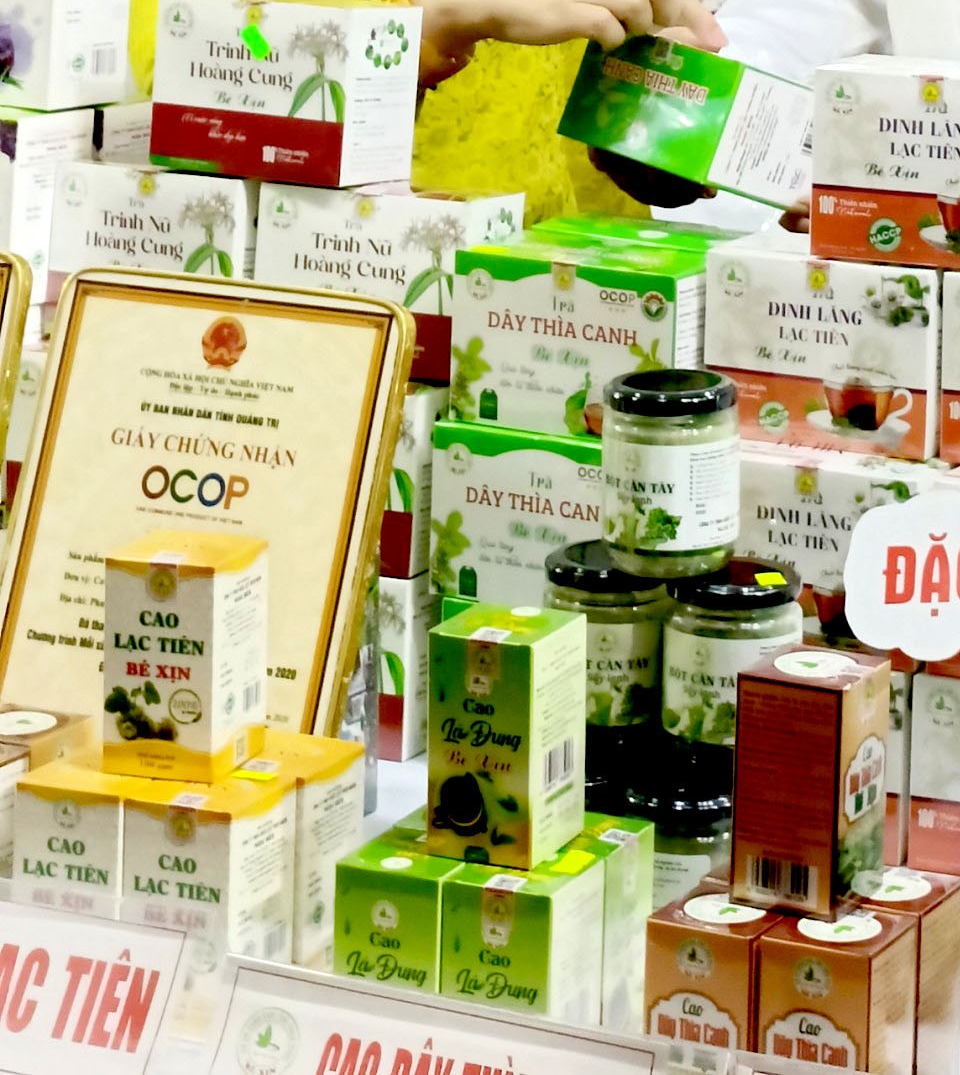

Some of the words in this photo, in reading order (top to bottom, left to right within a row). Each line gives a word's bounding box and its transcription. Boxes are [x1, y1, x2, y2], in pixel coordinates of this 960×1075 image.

[248, 67, 294, 92] Cung
[141, 237, 184, 262] Cung
[357, 261, 407, 286] Cung
[599, 289, 636, 304] OCOP
[487, 308, 527, 332] DÂY
[530, 315, 578, 340] THÌA
[581, 323, 638, 347] CANH
[163, 432, 237, 461] CHỨNG
[239, 443, 298, 471] NHẬN
[141, 464, 250, 511] OCOP
[465, 483, 504, 507] DÂY
[507, 492, 555, 517] THÌA
[138, 609, 180, 630] CAO
[114, 633, 152, 655] LẠC
[157, 634, 205, 657] TIÊN
[126, 659, 151, 678] BÉ
[156, 665, 192, 684] XỊN
[274, 666, 297, 680] 2020
[462, 697, 496, 716] Cao
[46, 836, 86, 857] CAO
[22, 858, 59, 881] LẠC
[64, 862, 111, 886] TIÊN
[158, 854, 198, 875] CAO
[133, 875, 170, 898] LẠC
[176, 880, 222, 905] TIÊN
[369, 931, 402, 950] Cao
[478, 948, 512, 968] Cao
[51, 947, 161, 1055] TIÊN
[681, 996, 704, 1018] Cao
[797, 1016, 822, 1038] Cao
